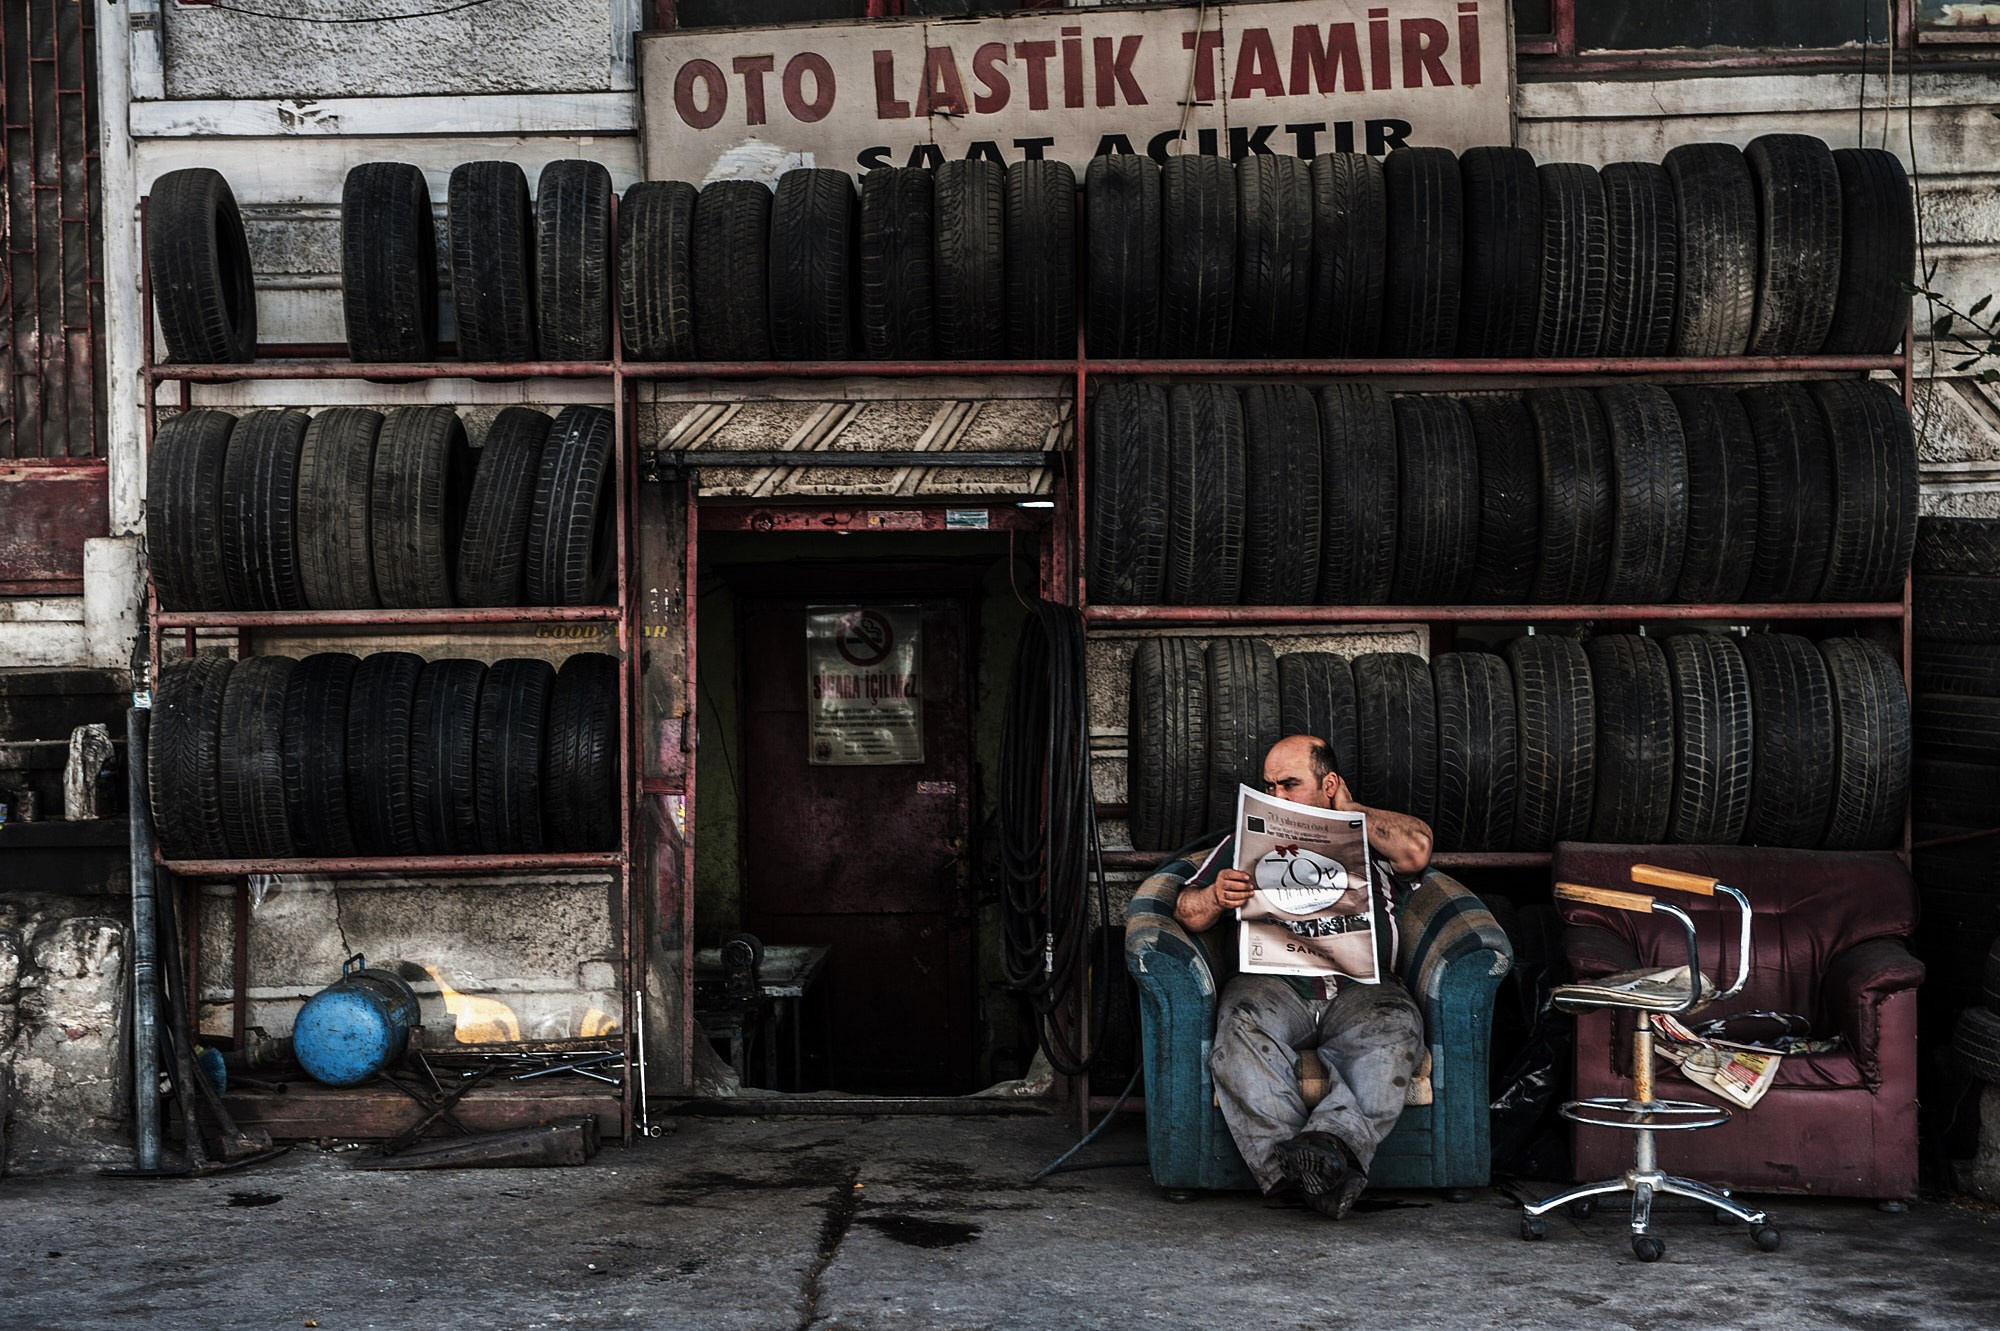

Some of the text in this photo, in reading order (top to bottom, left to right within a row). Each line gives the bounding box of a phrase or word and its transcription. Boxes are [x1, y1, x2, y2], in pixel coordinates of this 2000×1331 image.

[673, 2, 1482, 130] OTO LASTİK TAMİRİ
[856, 136, 1055, 185] SAAT
